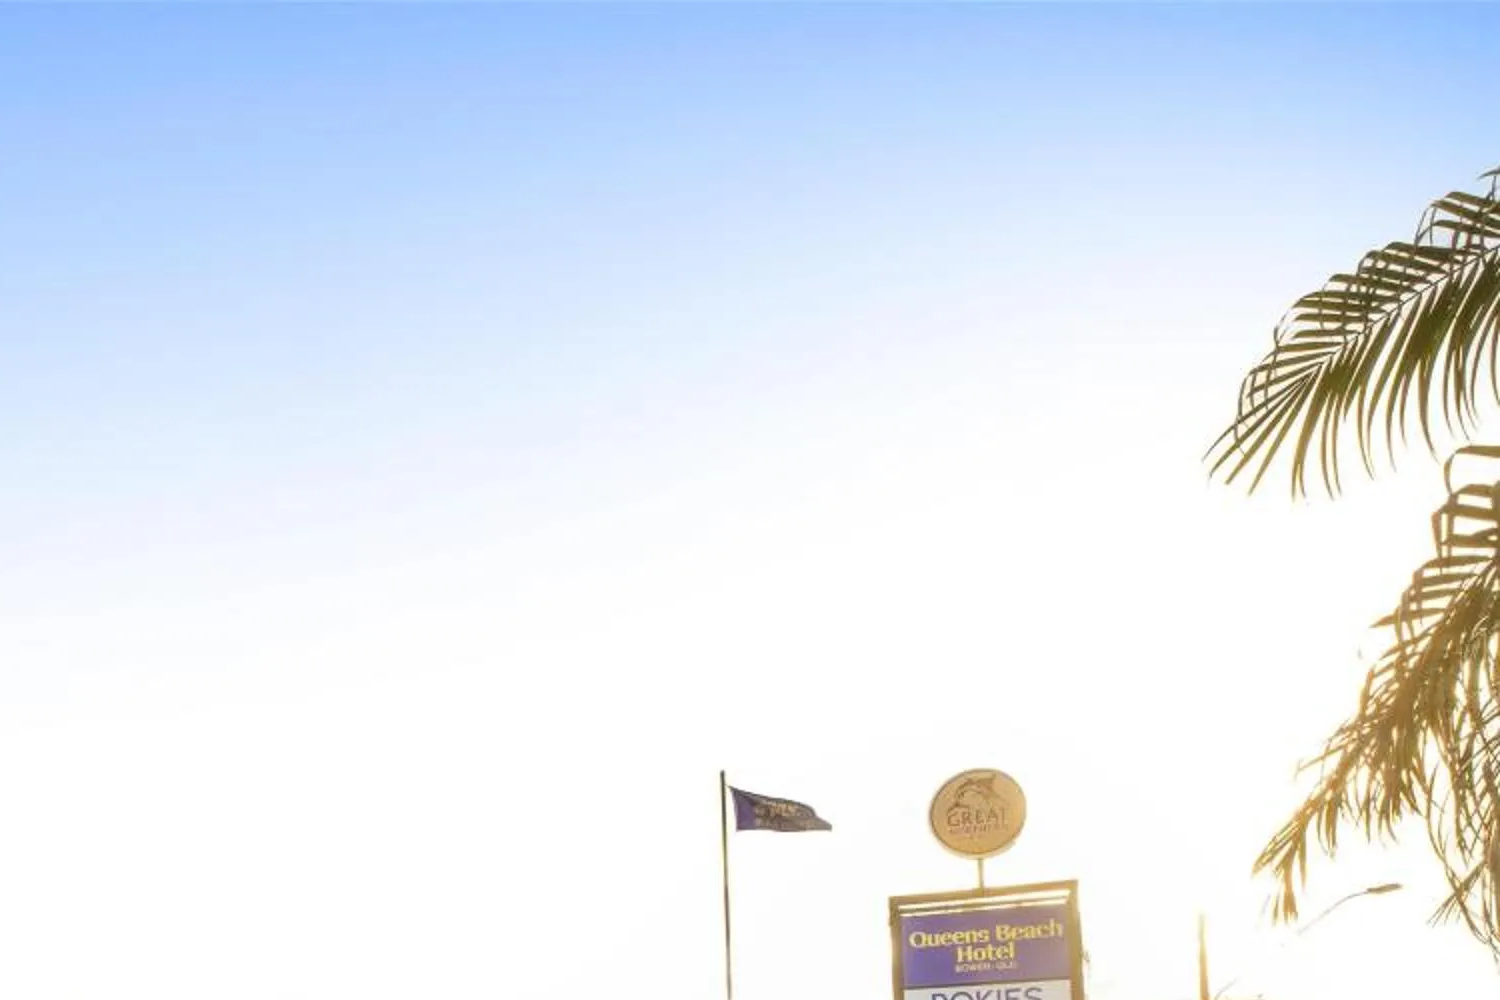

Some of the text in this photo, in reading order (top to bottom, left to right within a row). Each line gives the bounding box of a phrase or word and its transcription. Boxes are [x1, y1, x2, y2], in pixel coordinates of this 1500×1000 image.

[908, 918, 1064, 948] Queens Beach
[956, 942, 1016, 963] Hotel
